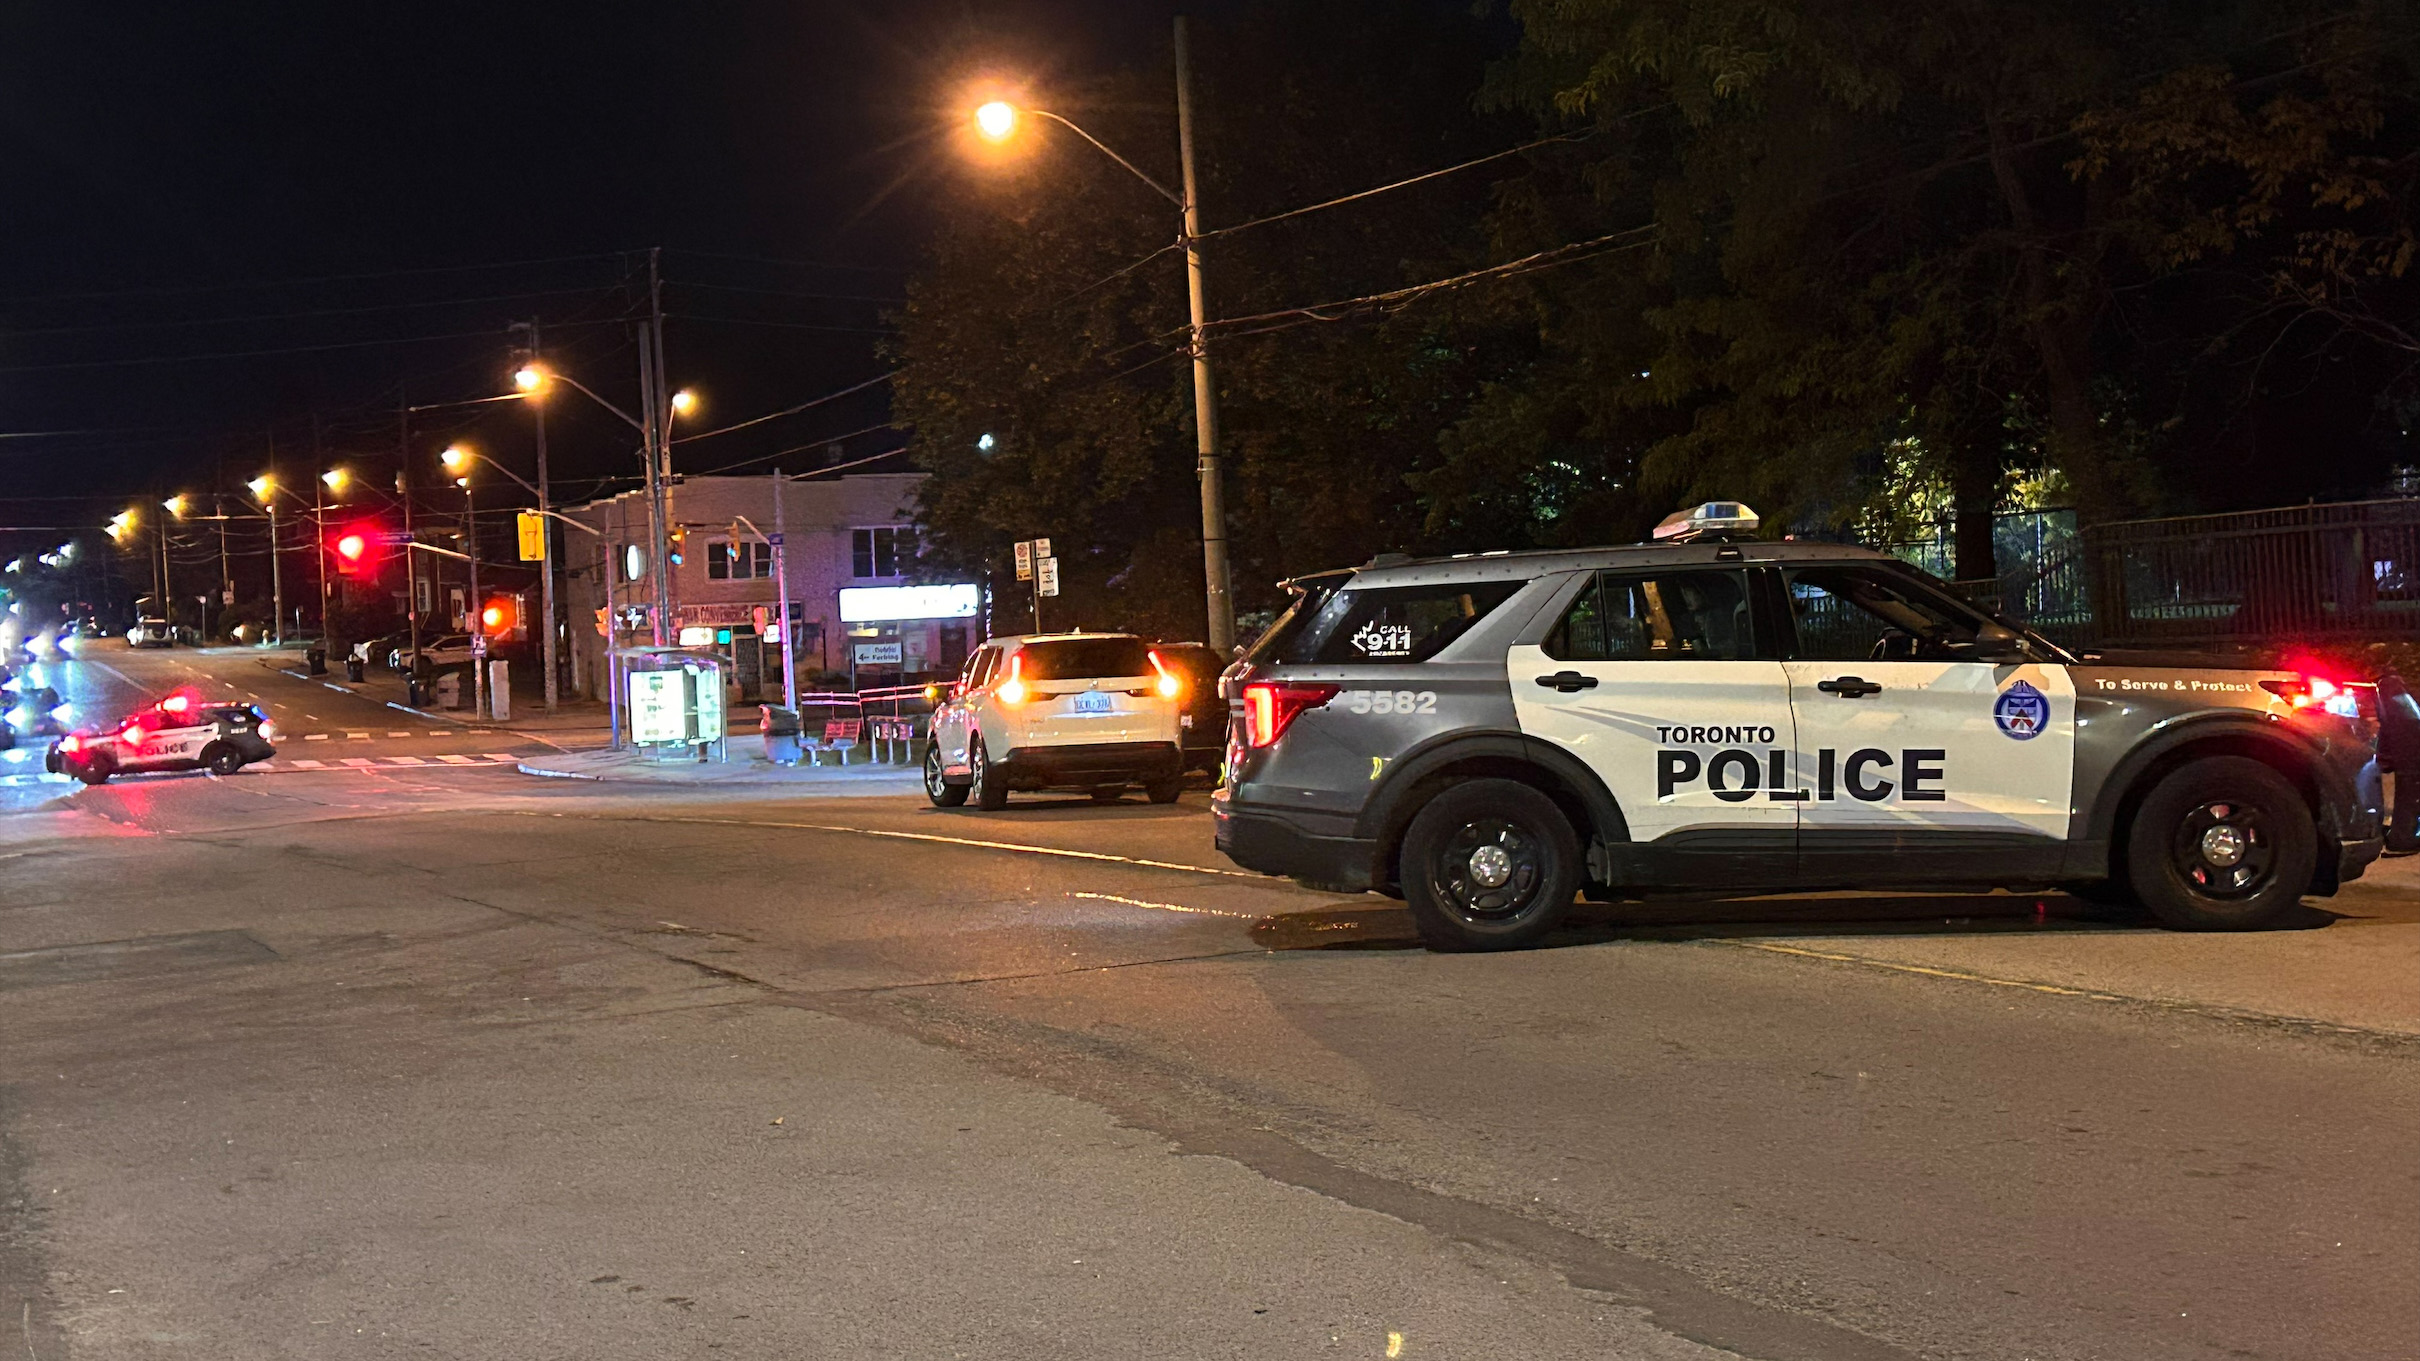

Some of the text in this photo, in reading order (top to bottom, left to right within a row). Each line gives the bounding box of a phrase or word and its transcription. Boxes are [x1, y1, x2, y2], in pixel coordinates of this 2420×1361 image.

[1380, 625, 1411, 634] CALL
[2095, 678, 2252, 692] To Serve & Protect
[1350, 690, 1437, 714] 5582
[1657, 726, 1775, 743] TORONTO
[1657, 748, 1946, 801] POLICE
